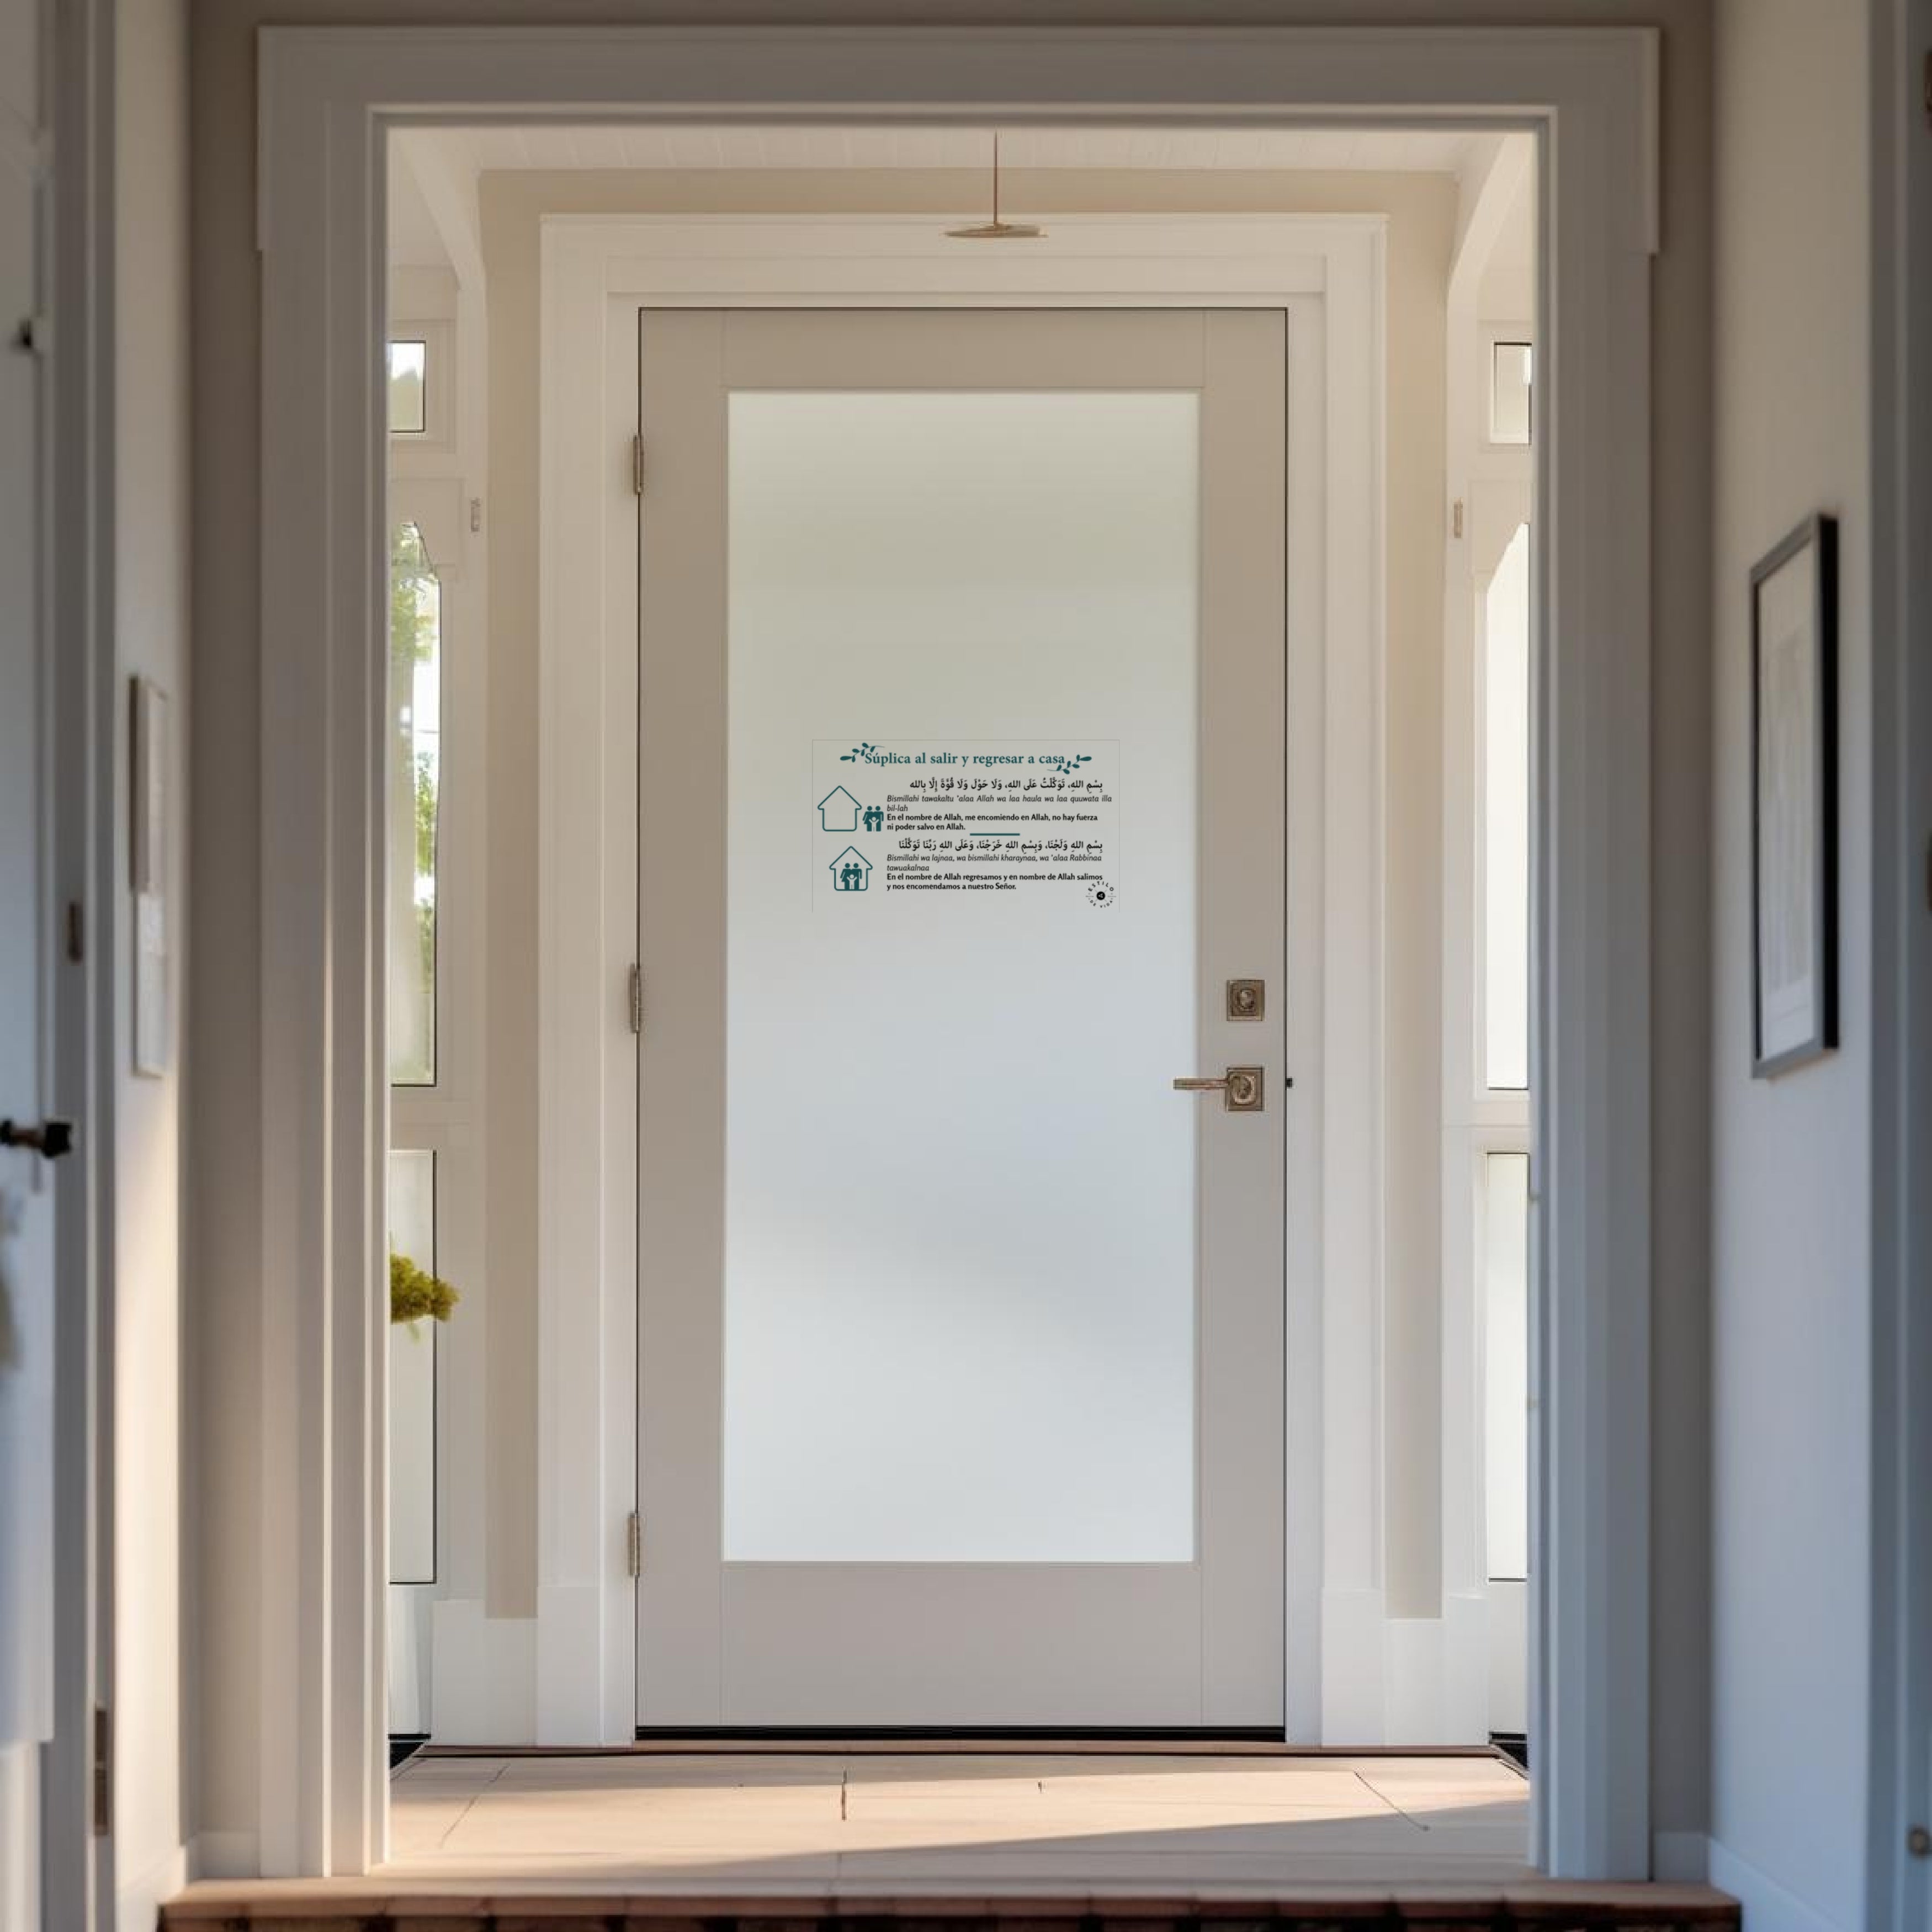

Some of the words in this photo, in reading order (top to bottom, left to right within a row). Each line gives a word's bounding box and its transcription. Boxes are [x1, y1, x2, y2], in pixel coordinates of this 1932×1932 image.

[864, 752, 911, 767] Súplica
[915, 752, 926, 764] al
[930, 752, 958, 764] salir
[961, 756, 969, 768] y
[973, 755, 1025, 768] regresar
[1027, 756, 1035, 764] a
[1038, 755, 1065, 765] casa
[887, 794, 920, 803] Bismillahi
[921, 794, 954, 803] tawakaltu
[1022, 794, 1042, 803] haula
[1070, 795, 1099, 804] quuwata
[1101, 794, 1112, 803] illa
[887, 804, 909, 812] bil-lah
[887, 813, 896, 821] En
[897, 813, 904, 821] el
[933, 813, 943, 821] de
[943, 813, 964, 821] Allah,
[976, 813, 1020, 821] encomiendo
[1031, 813, 1051, 821] Allah,
[1062, 813, 1075, 822] hay
[895, 822, 916, 832] poder
[916, 822, 935, 831] salvo
[887, 853, 919, 862] Bismillahi
[931, 853, 955, 863] lajnaa,
[967, 853, 1000, 862] bismillahi
[1000, 853, 1038, 863] kharaynaa,
[1069, 853, 1102, 862] Rabbinaa
[887, 863, 930, 872] tawuakalnaa
[995, 882, 1017, 890] Señor.
[1087, 881, 1114, 892] ESTILO
